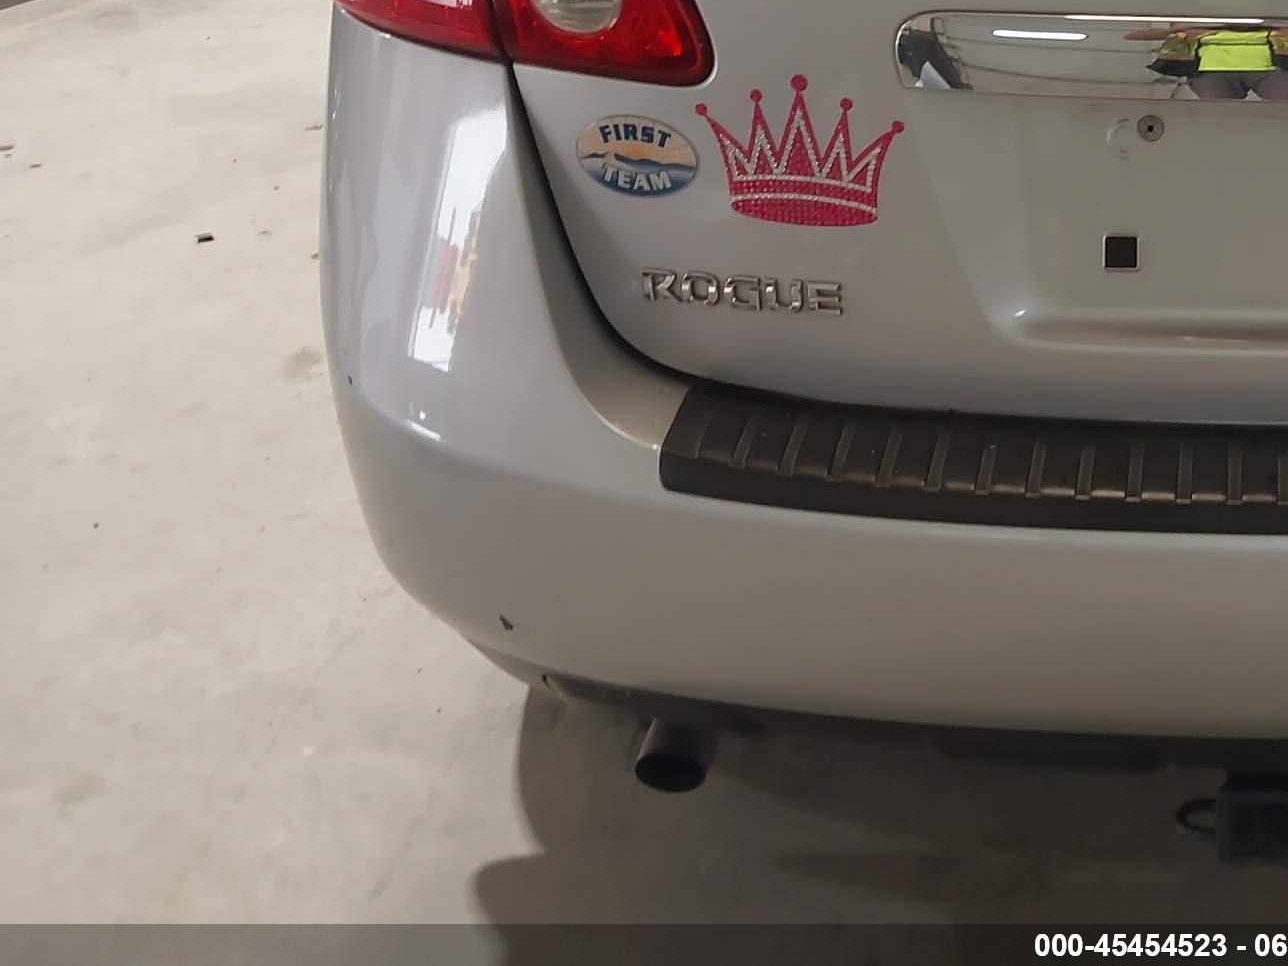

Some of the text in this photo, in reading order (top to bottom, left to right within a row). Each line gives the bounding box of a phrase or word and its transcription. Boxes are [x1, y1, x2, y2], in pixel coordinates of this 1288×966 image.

[598, 123, 672, 148] FIRST
[601, 162, 672, 191] TEAM
[642, 267, 843, 315] ROGUE
